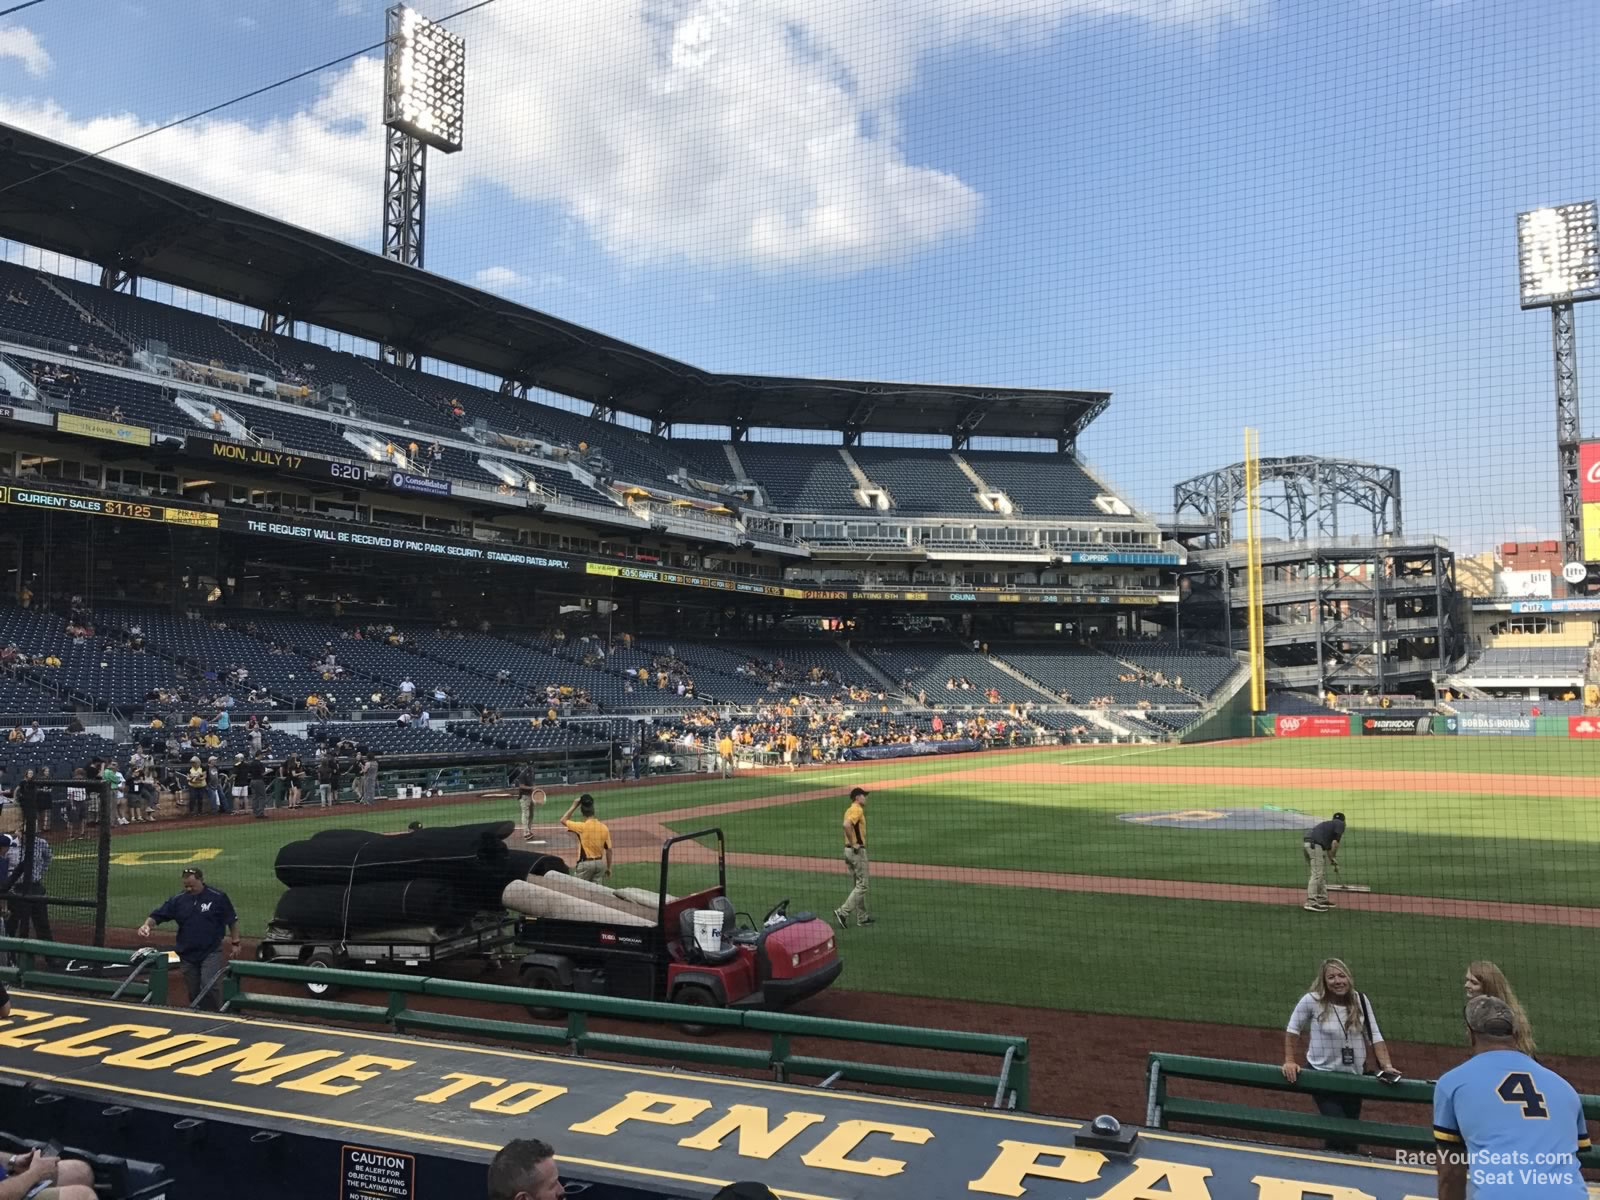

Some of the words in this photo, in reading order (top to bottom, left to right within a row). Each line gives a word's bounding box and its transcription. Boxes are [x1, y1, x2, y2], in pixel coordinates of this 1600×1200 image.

[213, 443, 248, 462] MON,
[252, 451, 282, 466] JULY
[286, 456, 302, 469] 17
[331, 463, 361, 480] 6:20
[405, 476, 448, 490] Consolidated
[18, 493, 68, 507] CURRENT
[70, 500, 101, 511] SALES
[105, 502, 151, 518] $1,125
[248, 520, 267, 532] THE
[269, 523, 312, 537] REQUEST
[314, 529, 336, 540] WILL
[338, 532, 349, 542] BE
[351, 533, 392, 547] RECEIVED
[393, 539, 404, 549] BY
[406, 541, 423, 551] PNC
[424, 543, 446, 554] PARK
[447, 546, 485, 559] SECURITY.
[487, 551, 525, 564] STANDARD
[526, 556, 547, 567] RATES
[548, 559, 570, 569] APPLY.
[1080, 554, 1109, 562] KOPPERS
[639, 570, 658, 580] RAFFLE
[1565, 567, 1584, 577] Lite
[884, 592, 898, 600] 6TH
[950, 593, 977, 601] OSUNA
[1462, 719, 1494, 728] BORDAS
[1497, 719, 1530, 728] BORDAS
[1495, 1071, 1550, 1120] 4
[414, 1072, 568, 1115] TO
[568, 1091, 935, 1177] PNC
[968, 1139, 1440, 1200] PA
[351, 1151, 405, 1169] CAUTION
[348, 1171, 377, 1181] OBJECTS
[377, 1177, 405, 1187] LEAVING
[365, 1166, 386, 1175] ALERT
[387, 1169, 400, 1177] FOR
[347, 1179, 359, 1187] THE
[360, 1182, 388, 1192] PLAYING
[388, 1186, 408, 1196] FIELD
